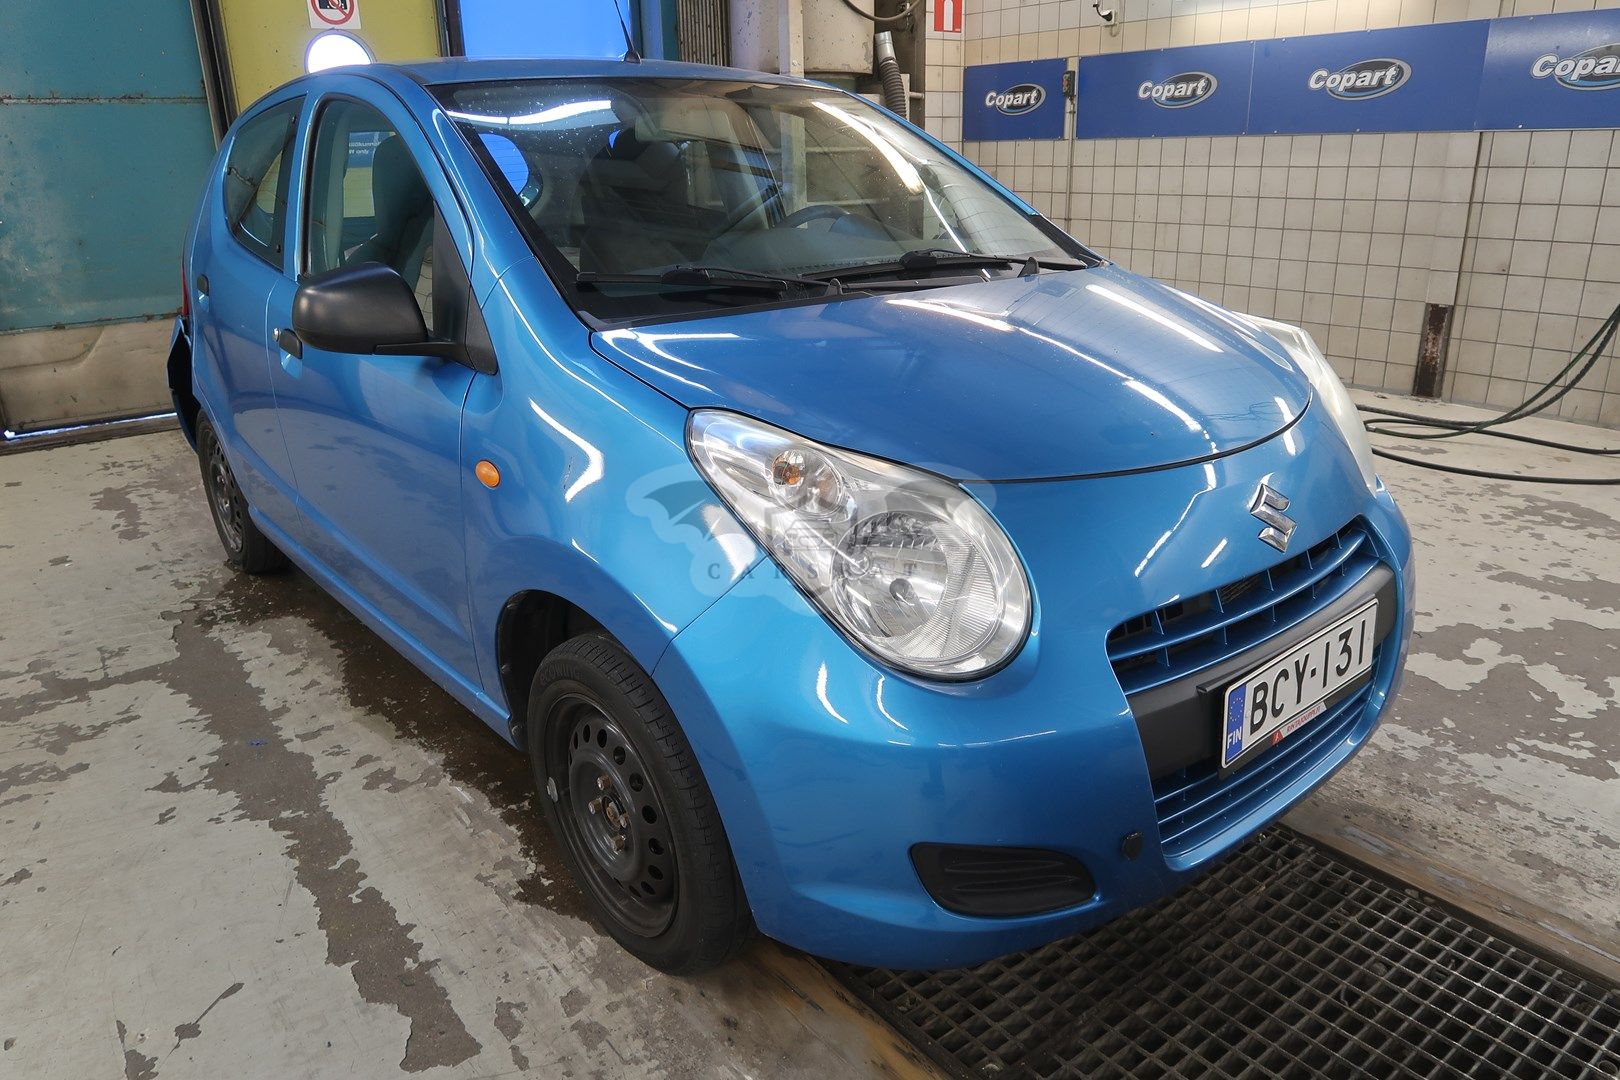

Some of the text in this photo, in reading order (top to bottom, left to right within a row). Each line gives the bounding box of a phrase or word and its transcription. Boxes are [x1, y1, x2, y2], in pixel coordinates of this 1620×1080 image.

[1309, 66, 1397, 92] Copart
[1531, 55, 1620, 81] Copa
[985, 89, 1038, 109] Copart
[1138, 79, 1206, 101] Copart
[1250, 619, 1366, 736] BCY-131
[1226, 726, 1242, 749] FIN
